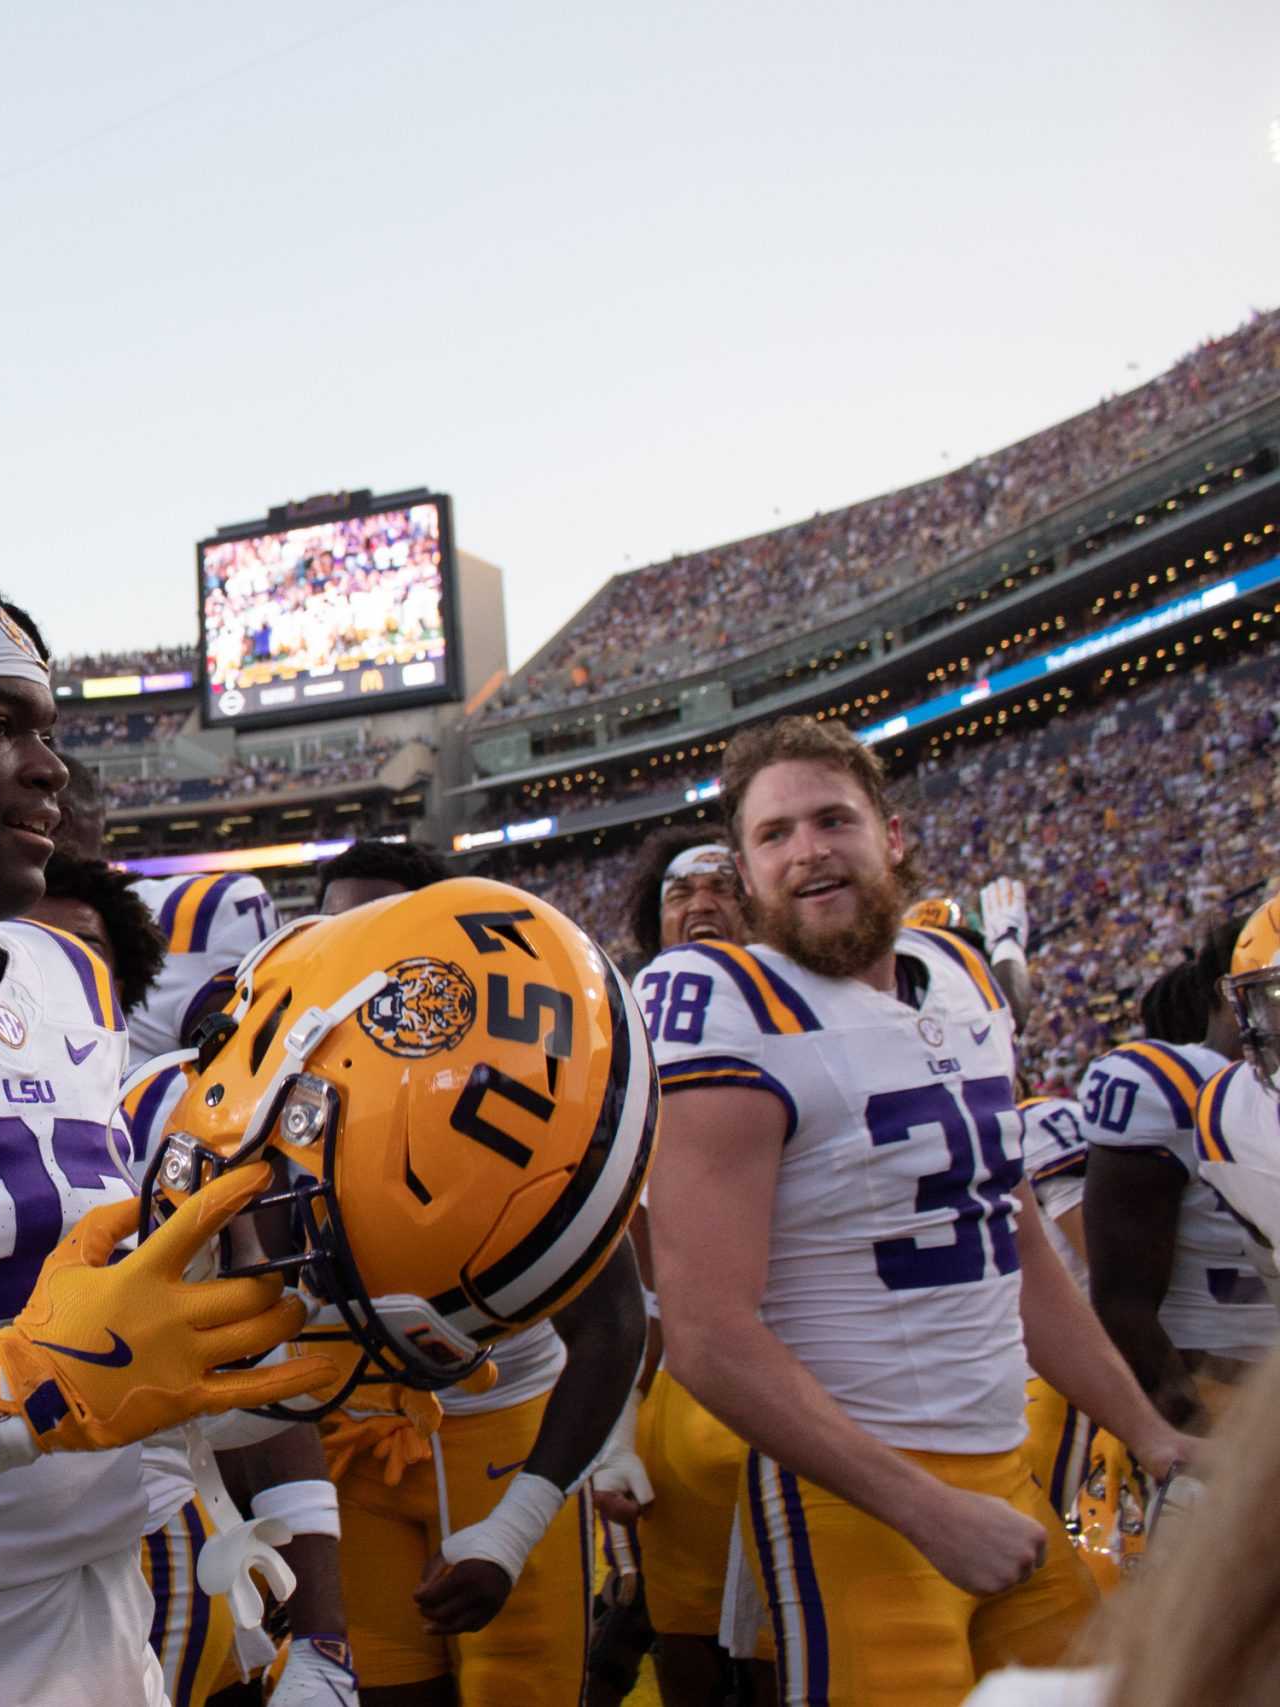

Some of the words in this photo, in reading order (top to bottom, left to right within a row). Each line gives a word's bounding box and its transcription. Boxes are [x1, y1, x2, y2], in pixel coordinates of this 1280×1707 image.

[450, 909, 573, 1169] LSU
[641, 971, 714, 1044] 38
[2, 1078, 56, 1103] LSU
[926, 1057, 961, 1075] LSU
[1084, 1069, 1140, 1134] 30
